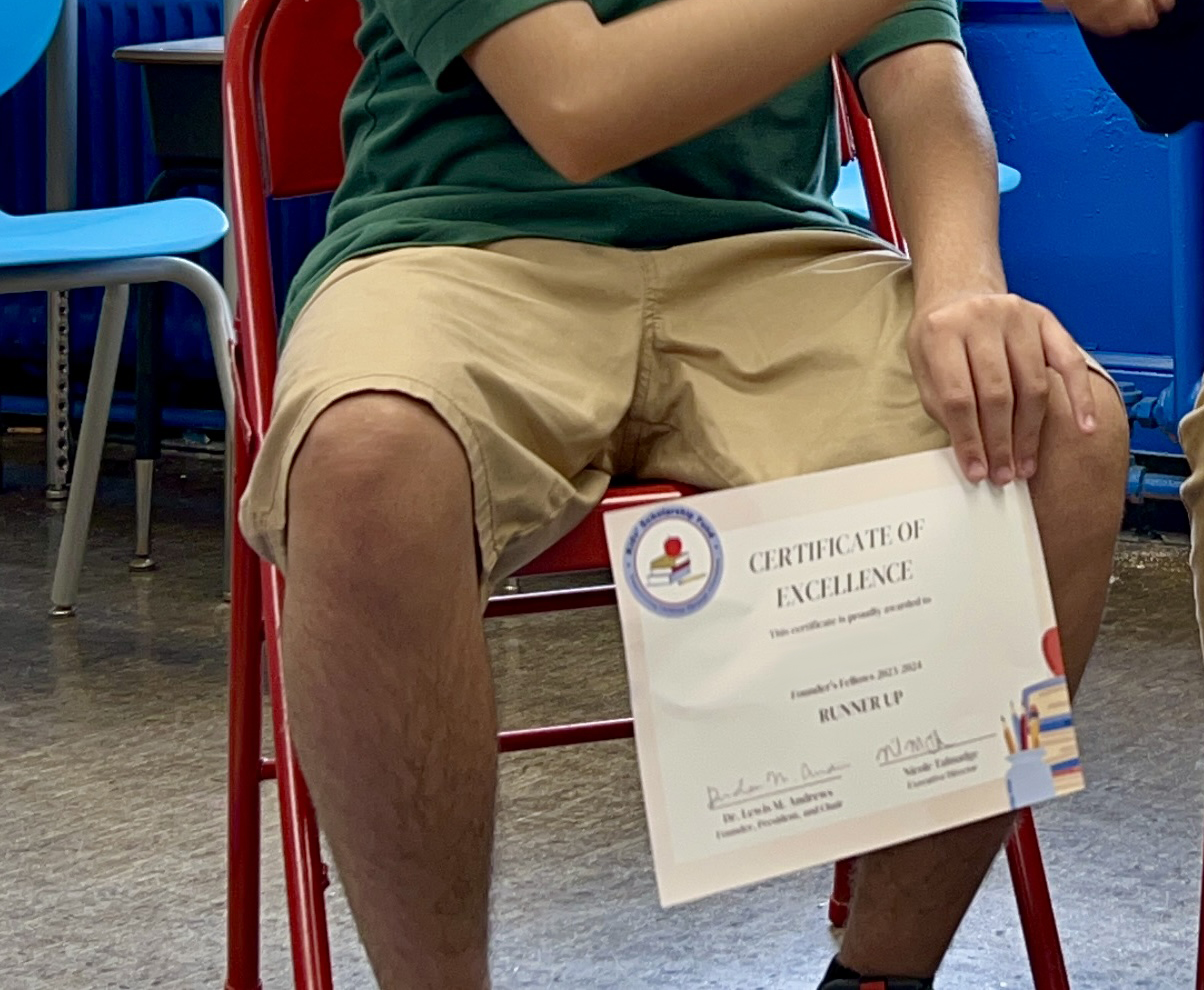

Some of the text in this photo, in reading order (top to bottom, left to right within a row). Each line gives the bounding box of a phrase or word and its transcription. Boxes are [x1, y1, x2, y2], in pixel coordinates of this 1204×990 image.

[749, 517, 926, 575] CERTIFICATE OF
[776, 560, 914, 609] EXCELLENCE
[769, 627, 790, 640] This
[791, 617, 836, 635] certificate
[847, 606, 882, 625] proudly
[884, 595, 922, 615] awarded
[790, 679, 839, 701] Founder's
[838, 673, 876, 689] Fellows
[818, 689, 904, 724] RUNNER UP
